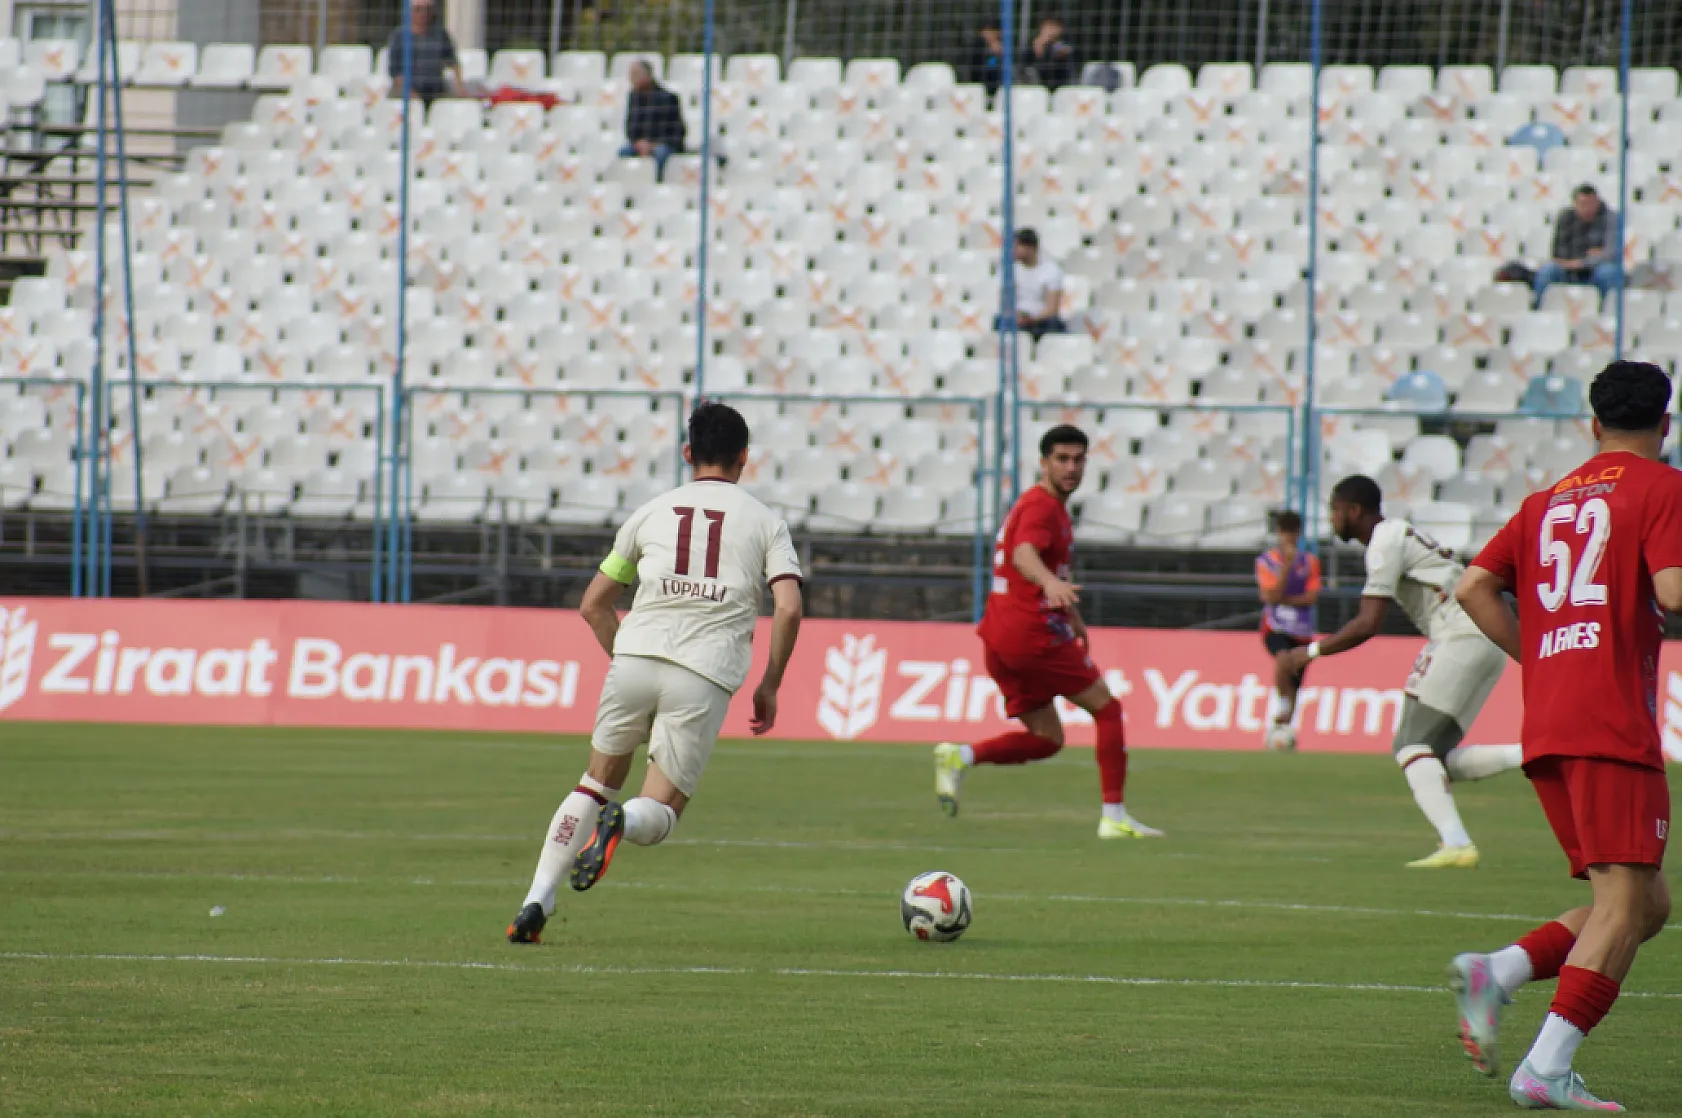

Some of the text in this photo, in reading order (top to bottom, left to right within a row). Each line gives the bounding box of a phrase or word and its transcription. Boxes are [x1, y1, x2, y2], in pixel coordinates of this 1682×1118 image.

[1549, 483, 1617, 507] BETON
[672, 506, 726, 579] 11
[1537, 498, 1611, 612] 52
[660, 577, 728, 603] TOPALLI
[41, 631, 580, 707] Ziraat Bankası
